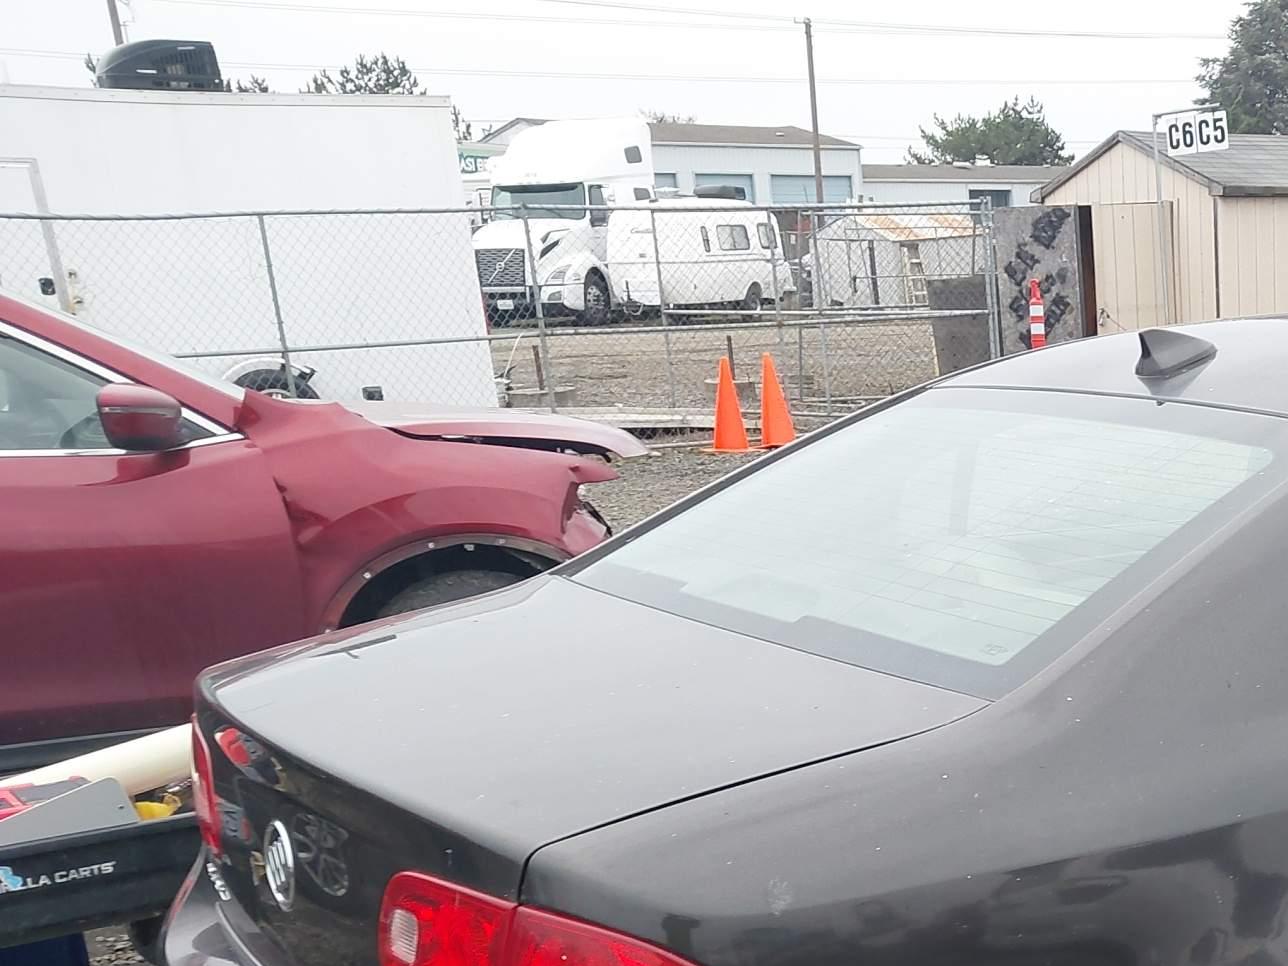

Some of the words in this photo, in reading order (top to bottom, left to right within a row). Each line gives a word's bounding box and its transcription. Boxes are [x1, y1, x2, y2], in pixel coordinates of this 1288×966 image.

[1168, 123, 1195, 150] C6
[1198, 117, 1226, 146] C5
[53, 861, 116, 884] CARTS
